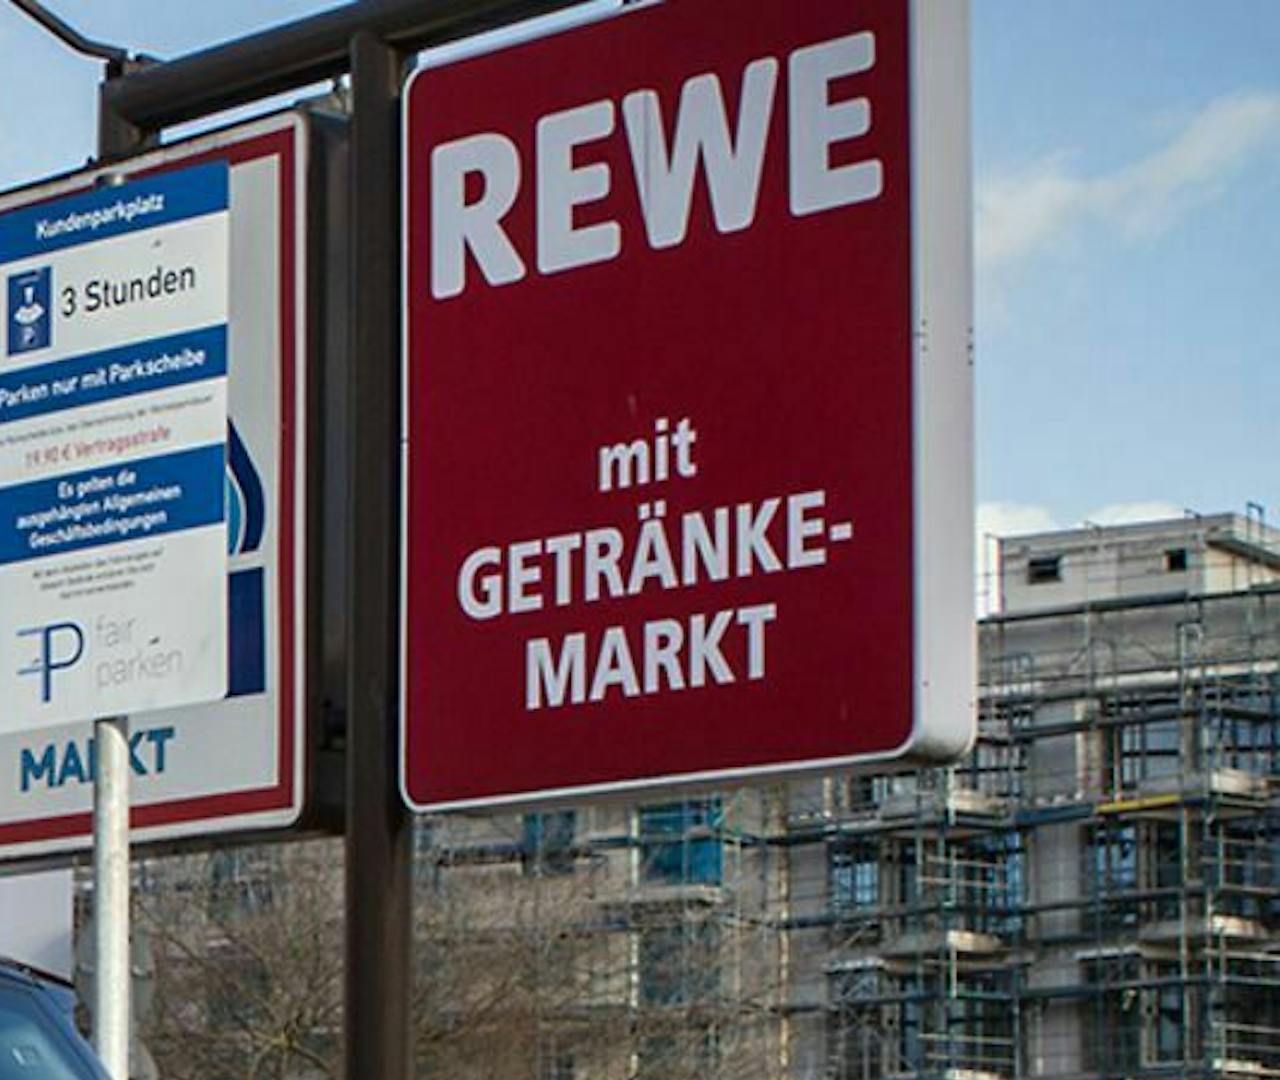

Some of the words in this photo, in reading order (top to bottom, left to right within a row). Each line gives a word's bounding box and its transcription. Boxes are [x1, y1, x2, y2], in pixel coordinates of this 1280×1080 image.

[430, 30, 884, 300] REWE
[36, 194, 164, 239] Kundenparkplatz
[61, 287, 77, 317] 3
[84, 266, 196, 312] Stunden
[52, 376, 78, 396] nur
[81, 368, 107, 388] mit
[109, 349, 206, 382] Parkscheibe
[597, 418, 698, 492] mit
[458, 490, 854, 620] GETRÄNKE-
[96, 613, 137, 647] fair
[525, 604, 777, 710] MARKT
[95, 649, 181, 689] parken
[20, 727, 175, 793] MAKT
